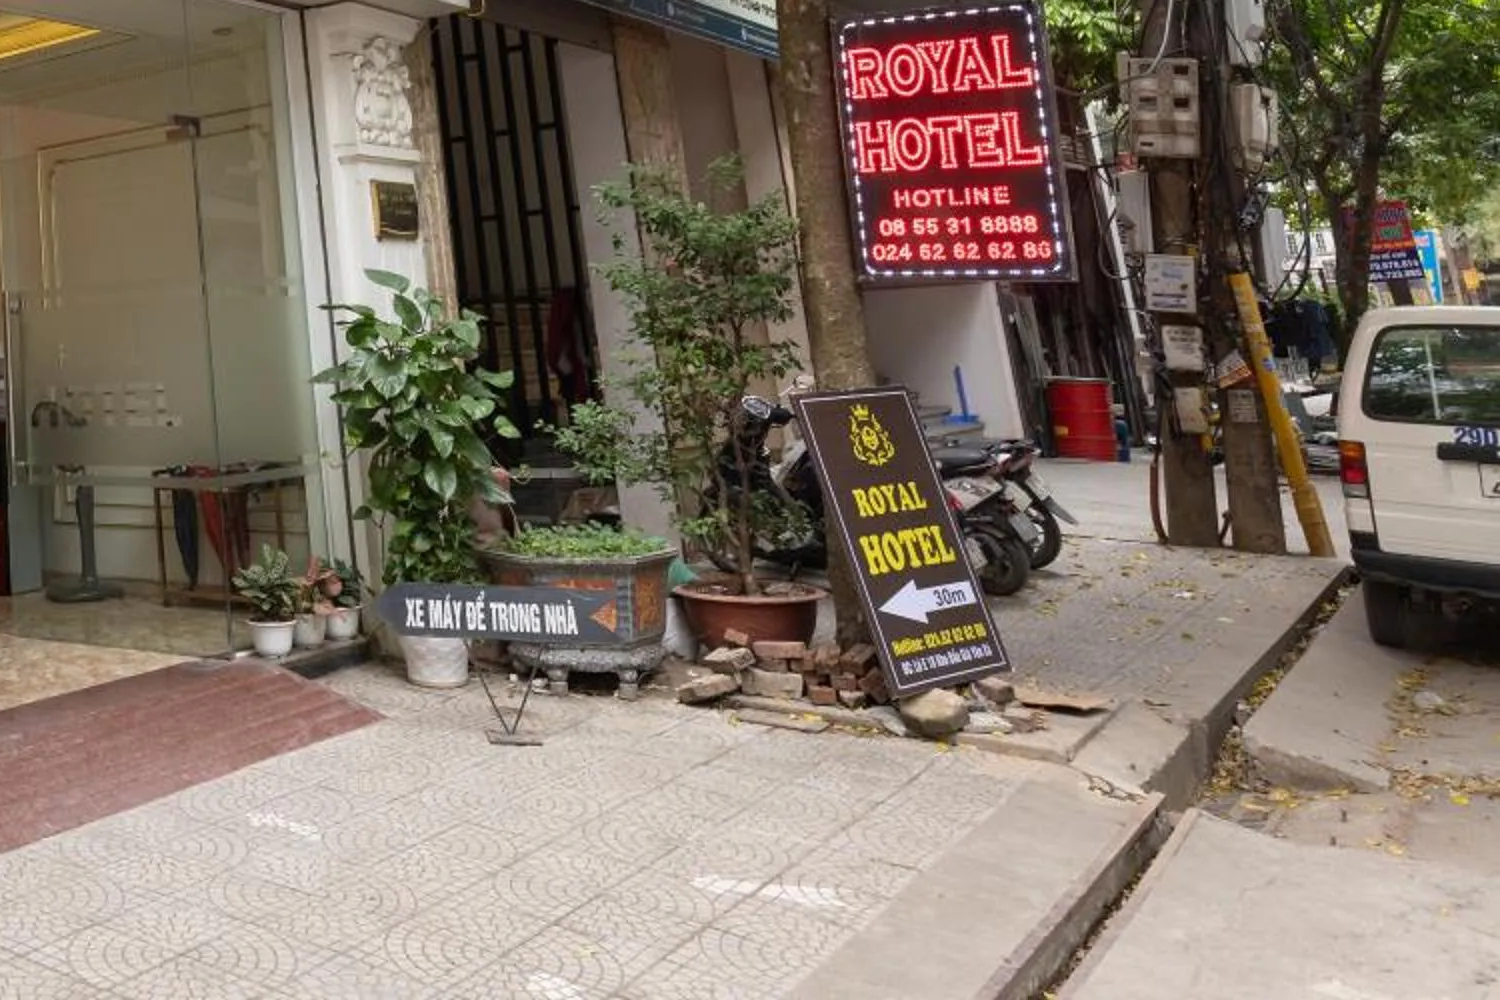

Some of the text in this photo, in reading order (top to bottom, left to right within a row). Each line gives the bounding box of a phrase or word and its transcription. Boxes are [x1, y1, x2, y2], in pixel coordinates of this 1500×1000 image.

[848, 34, 1033, 99] ROYAL
[855, 111, 1043, 173] HOTEL
[894, 186, 1011, 208] HOTLINE
[879, 215, 1038, 237] 08 55 31 8888
[873, 244, 912, 261] 024
[919, 243, 945, 260] 62
[953, 242, 980, 260] 62
[988, 241, 1016, 259] 62
[852, 481, 927, 517] ROYAL
[859, 525, 956, 575] HOTEL
[405, 590, 578, 636] XE MÁY ĐỂ TRONG NHÀ
[933, 588, 966, 606] 30m
